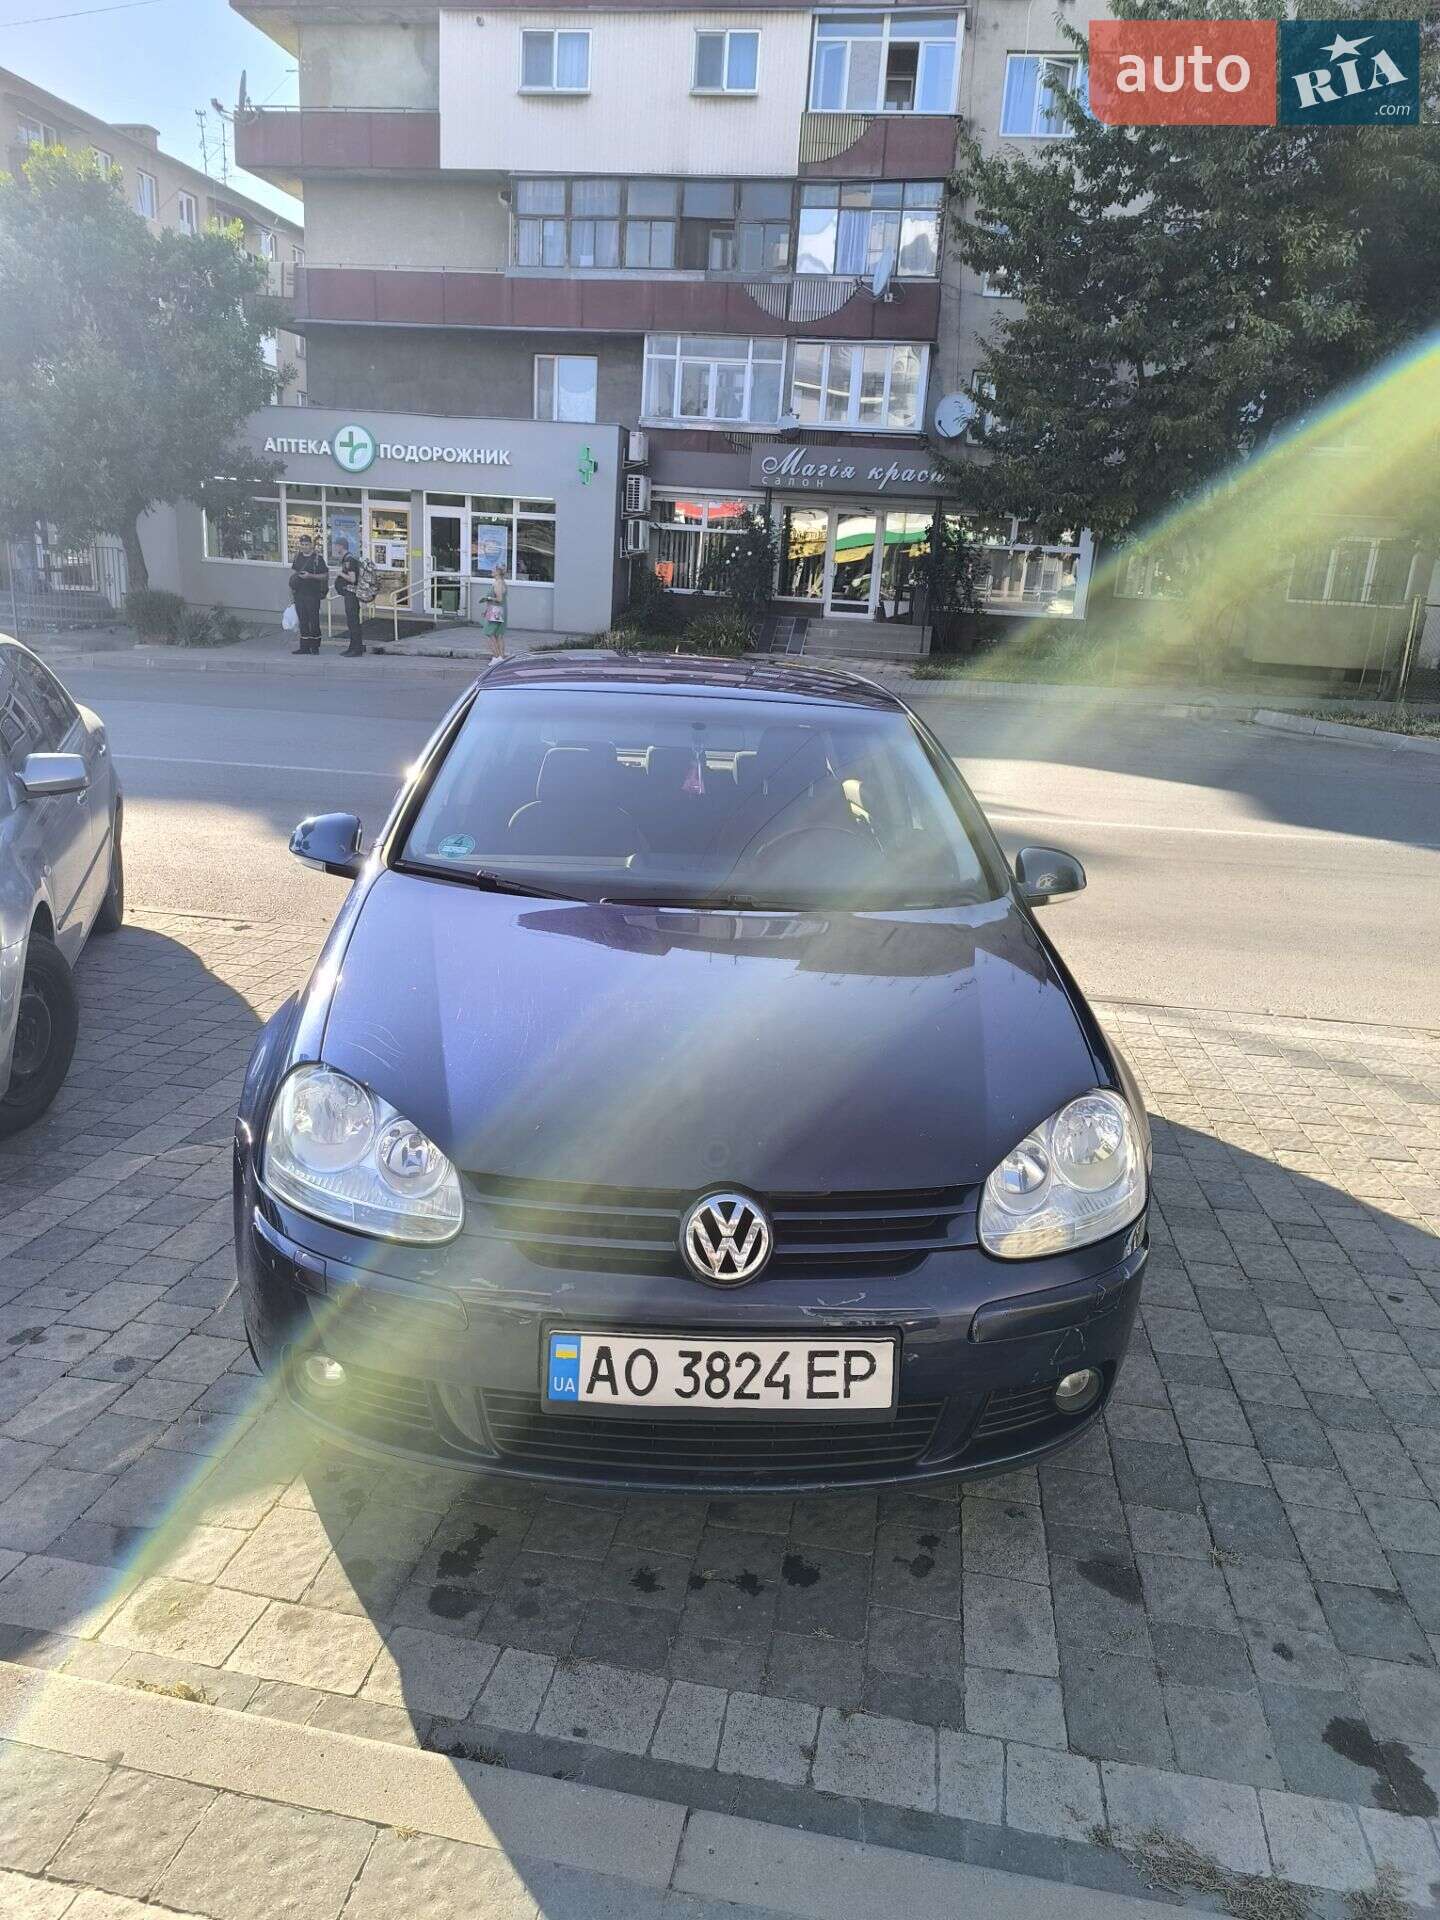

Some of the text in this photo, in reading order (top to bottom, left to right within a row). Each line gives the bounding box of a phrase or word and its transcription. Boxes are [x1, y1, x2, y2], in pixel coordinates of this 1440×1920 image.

[263, 437, 512, 465] АПТЕКА ПОДОРОЖНИК
[761, 448, 855, 479] Магія
[762, 476, 824, 488] салон
[553, 1377, 576, 1393] UA
[586, 1346, 877, 1400] AO 3824 EP
